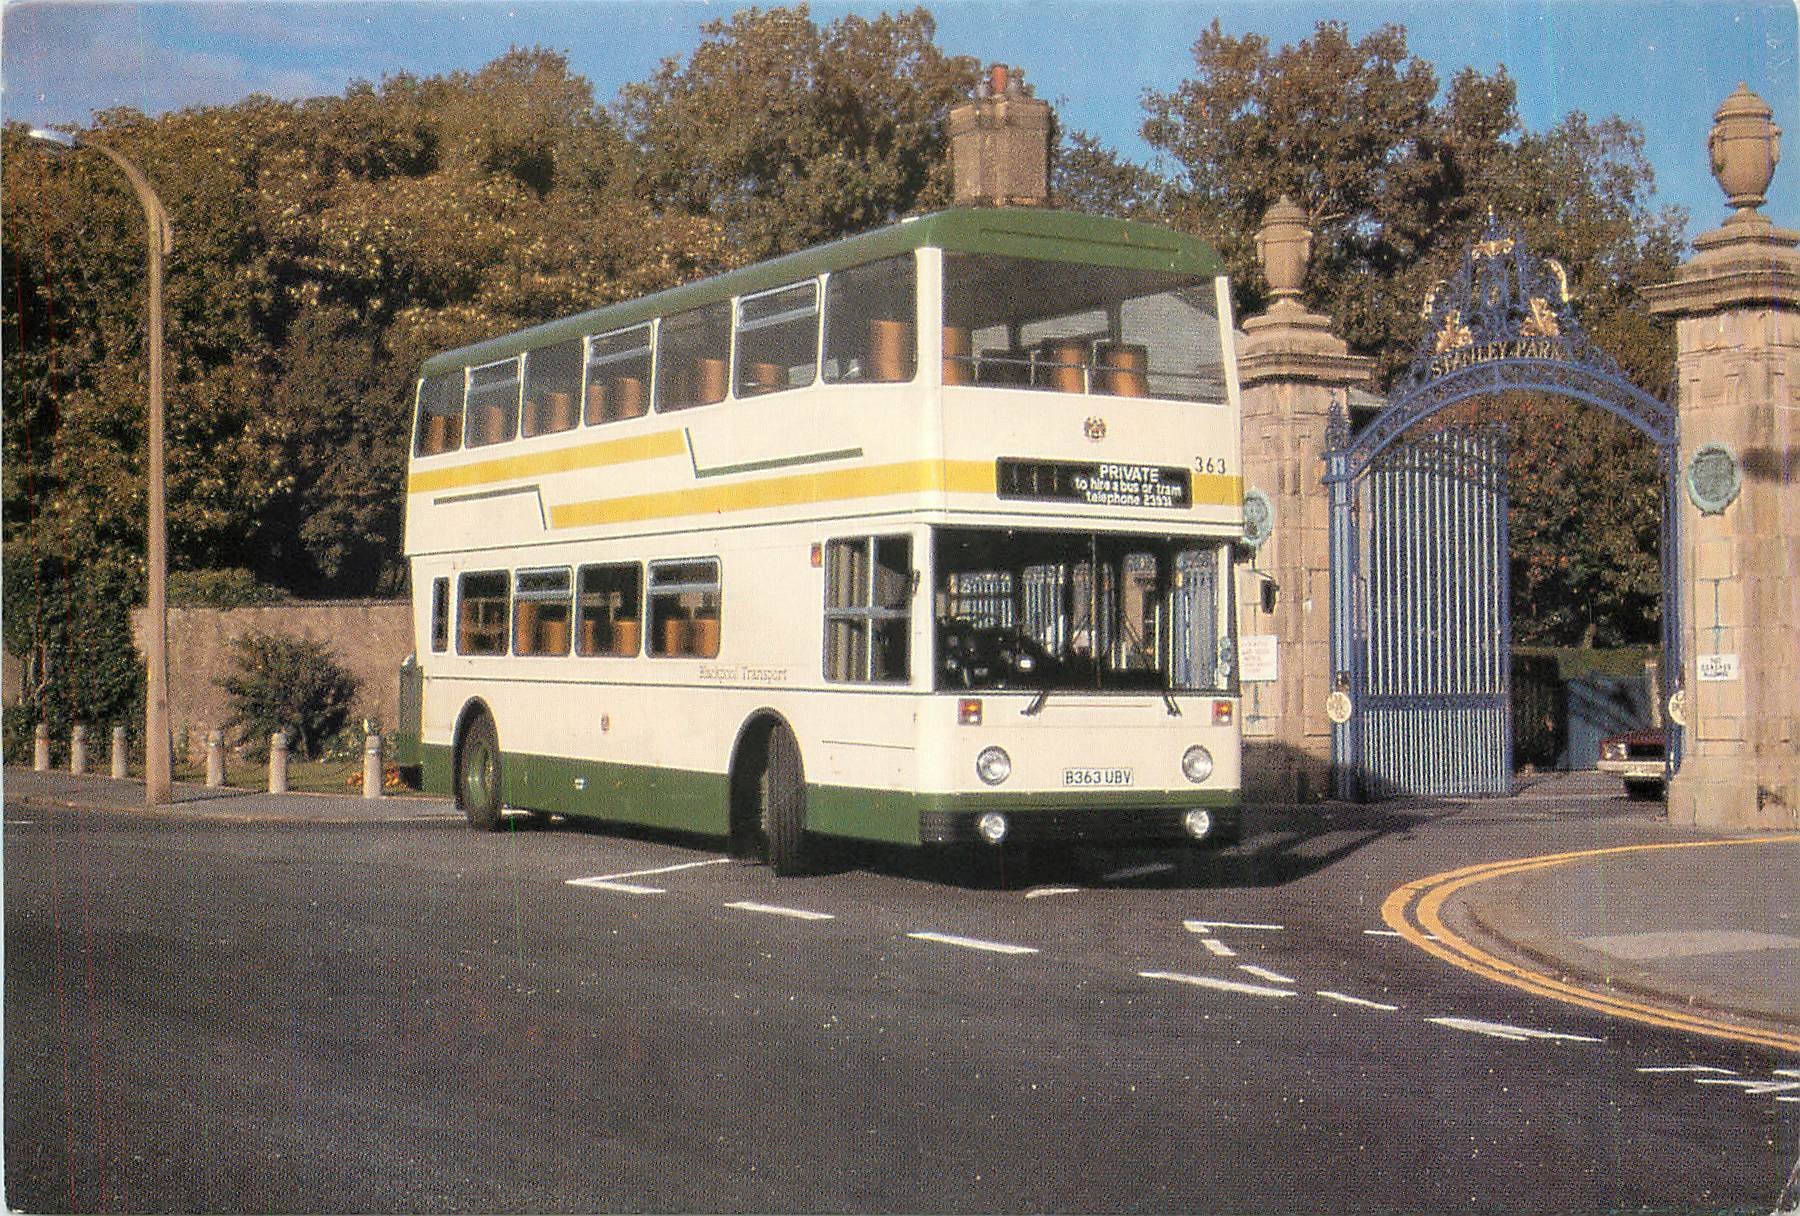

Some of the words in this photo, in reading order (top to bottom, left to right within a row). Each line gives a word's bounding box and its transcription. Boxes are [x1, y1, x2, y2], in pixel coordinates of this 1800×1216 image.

[1100, 464, 1160, 483] PRIVATE
[1194, 456, 1226, 474] 363
[1075, 478, 1088, 490] to
[1112, 482, 1119, 492] a
[1121, 480, 1139, 493] bus
[1142, 484, 1153, 494] or
[1156, 484, 1182, 498] tram
[1087, 491, 1140, 506] telephone
[741, 666, 788, 684] Transport
[1065, 770, 1101, 784] B363
[1105, 770, 1131, 784] UBV
